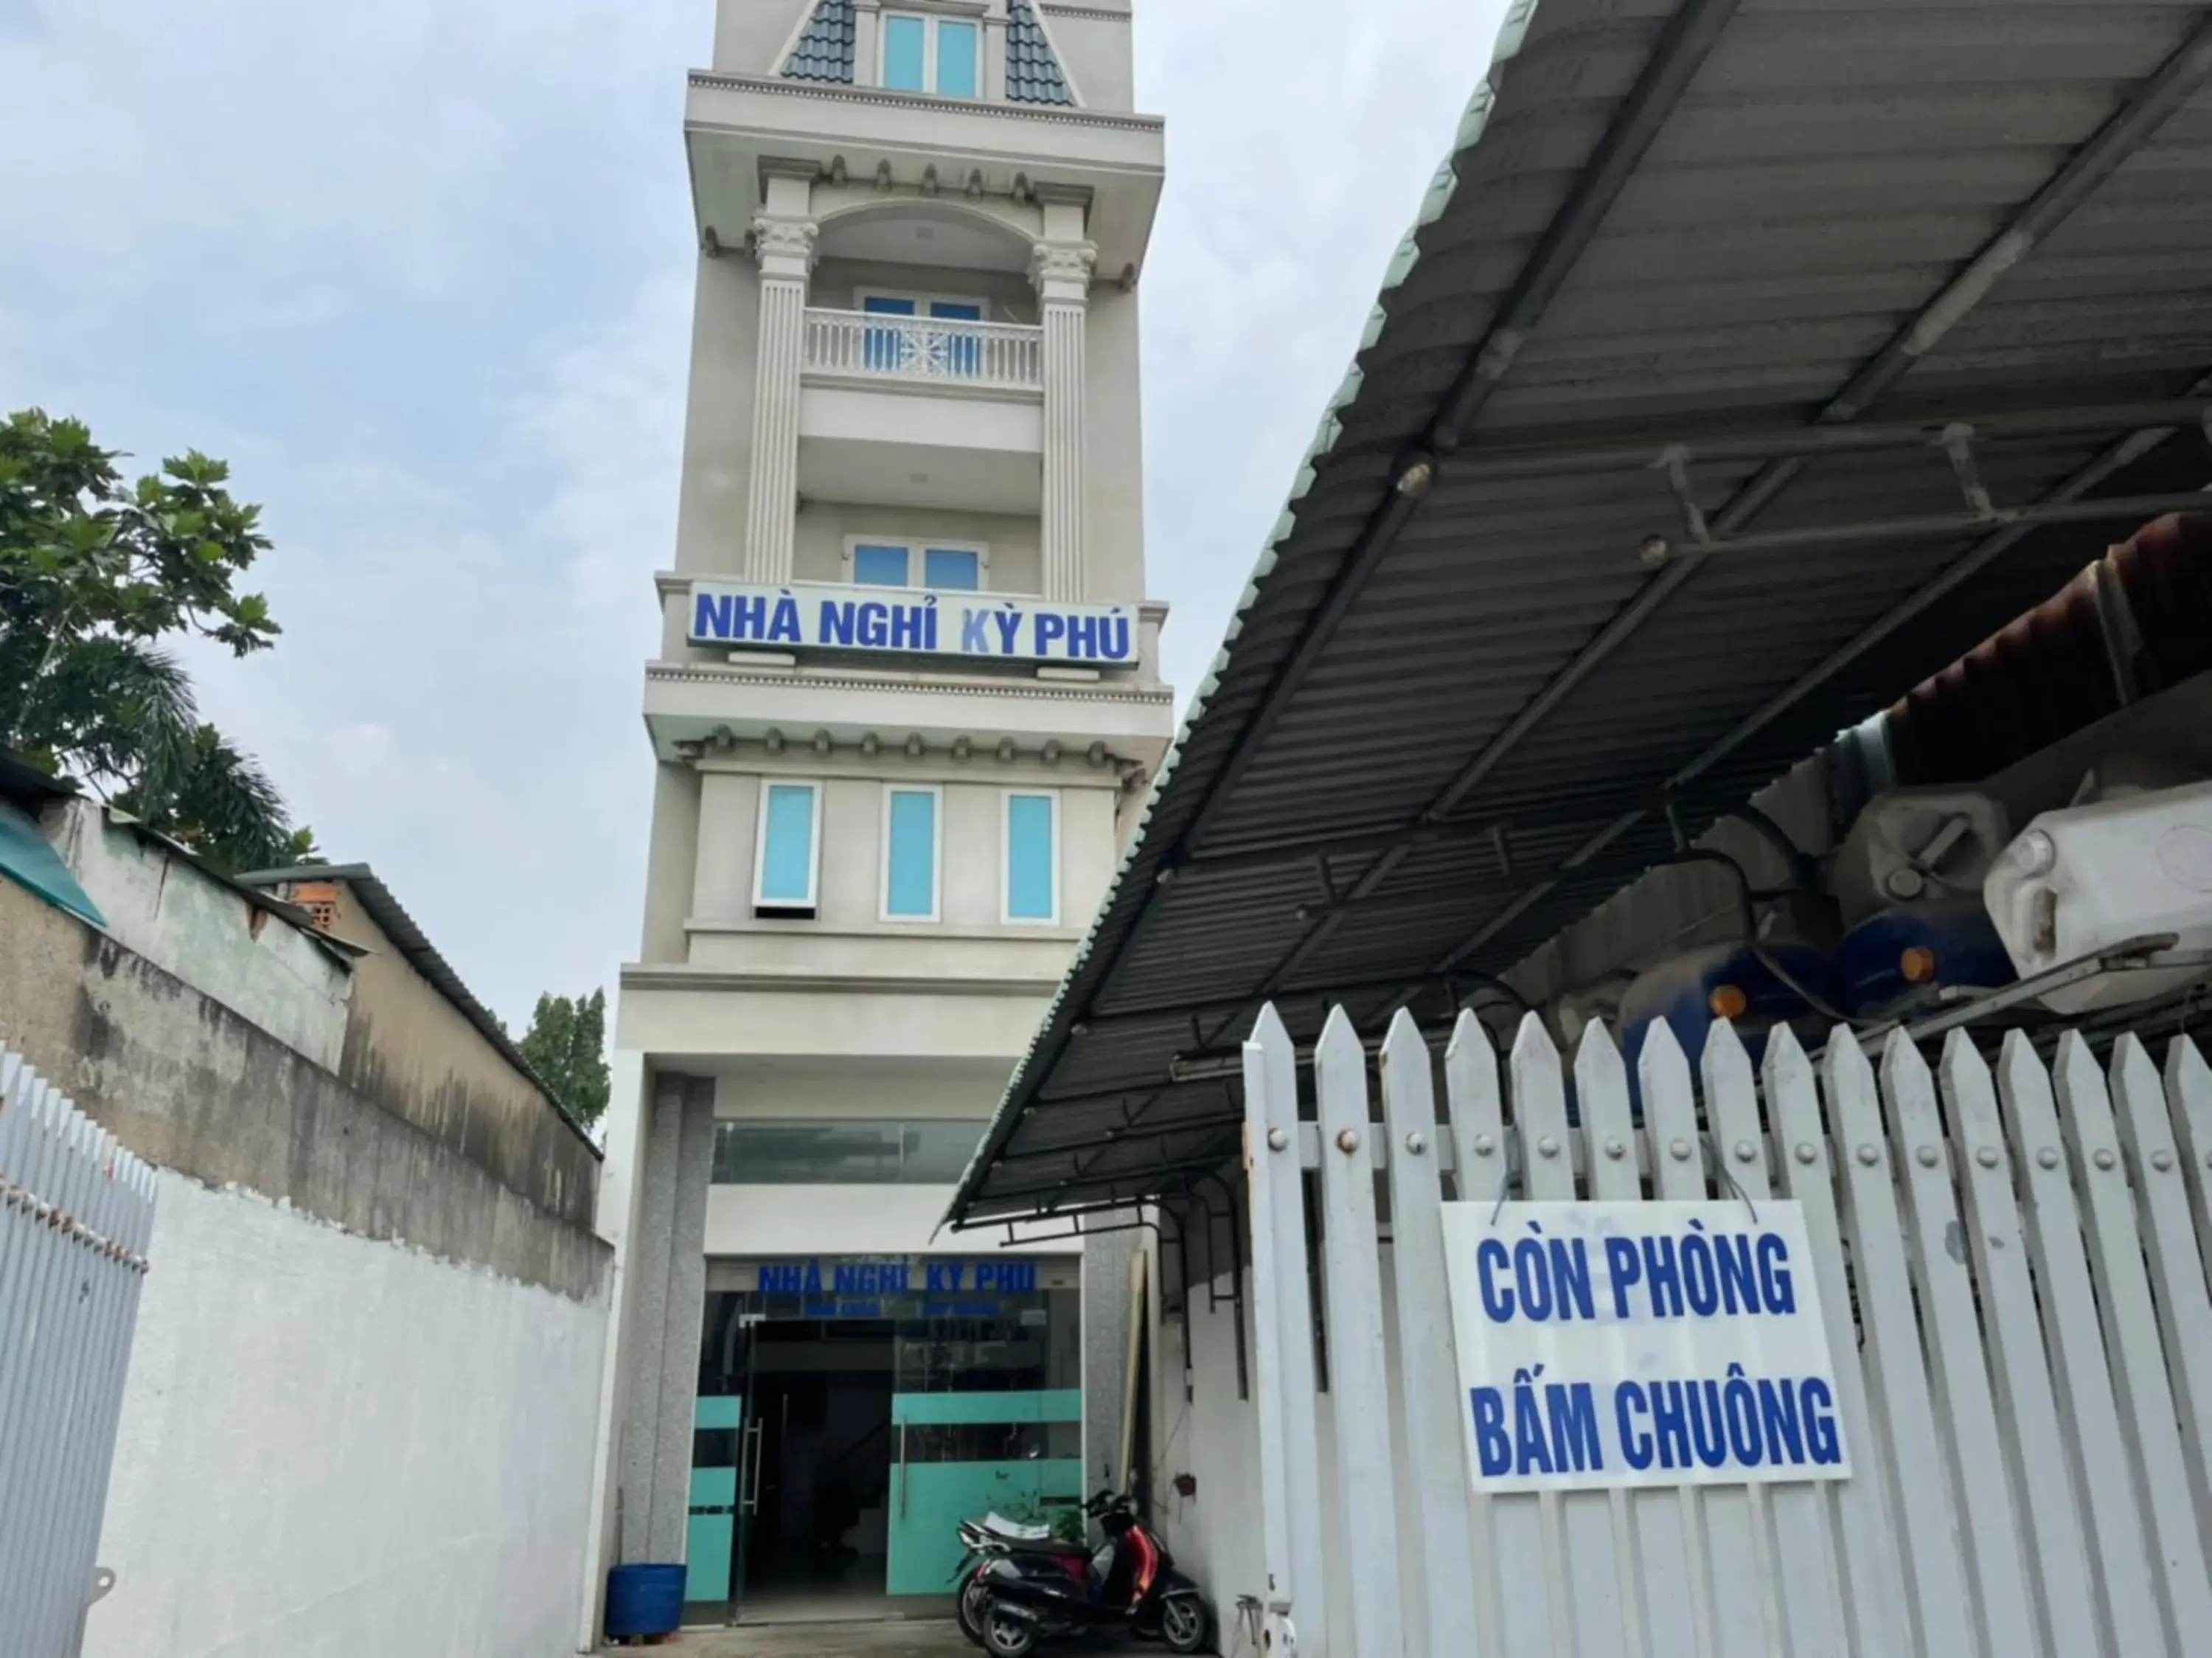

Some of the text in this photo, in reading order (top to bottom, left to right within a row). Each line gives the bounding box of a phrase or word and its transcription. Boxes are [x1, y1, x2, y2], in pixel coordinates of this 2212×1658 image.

[694, 589, 1130, 660] NHÀ NGHỈ KỲ PHÚ
[1476, 1218, 1796, 1322] CÒN PHÒNG
[1470, 1362, 1842, 1477] BẤM CHUÔNG
